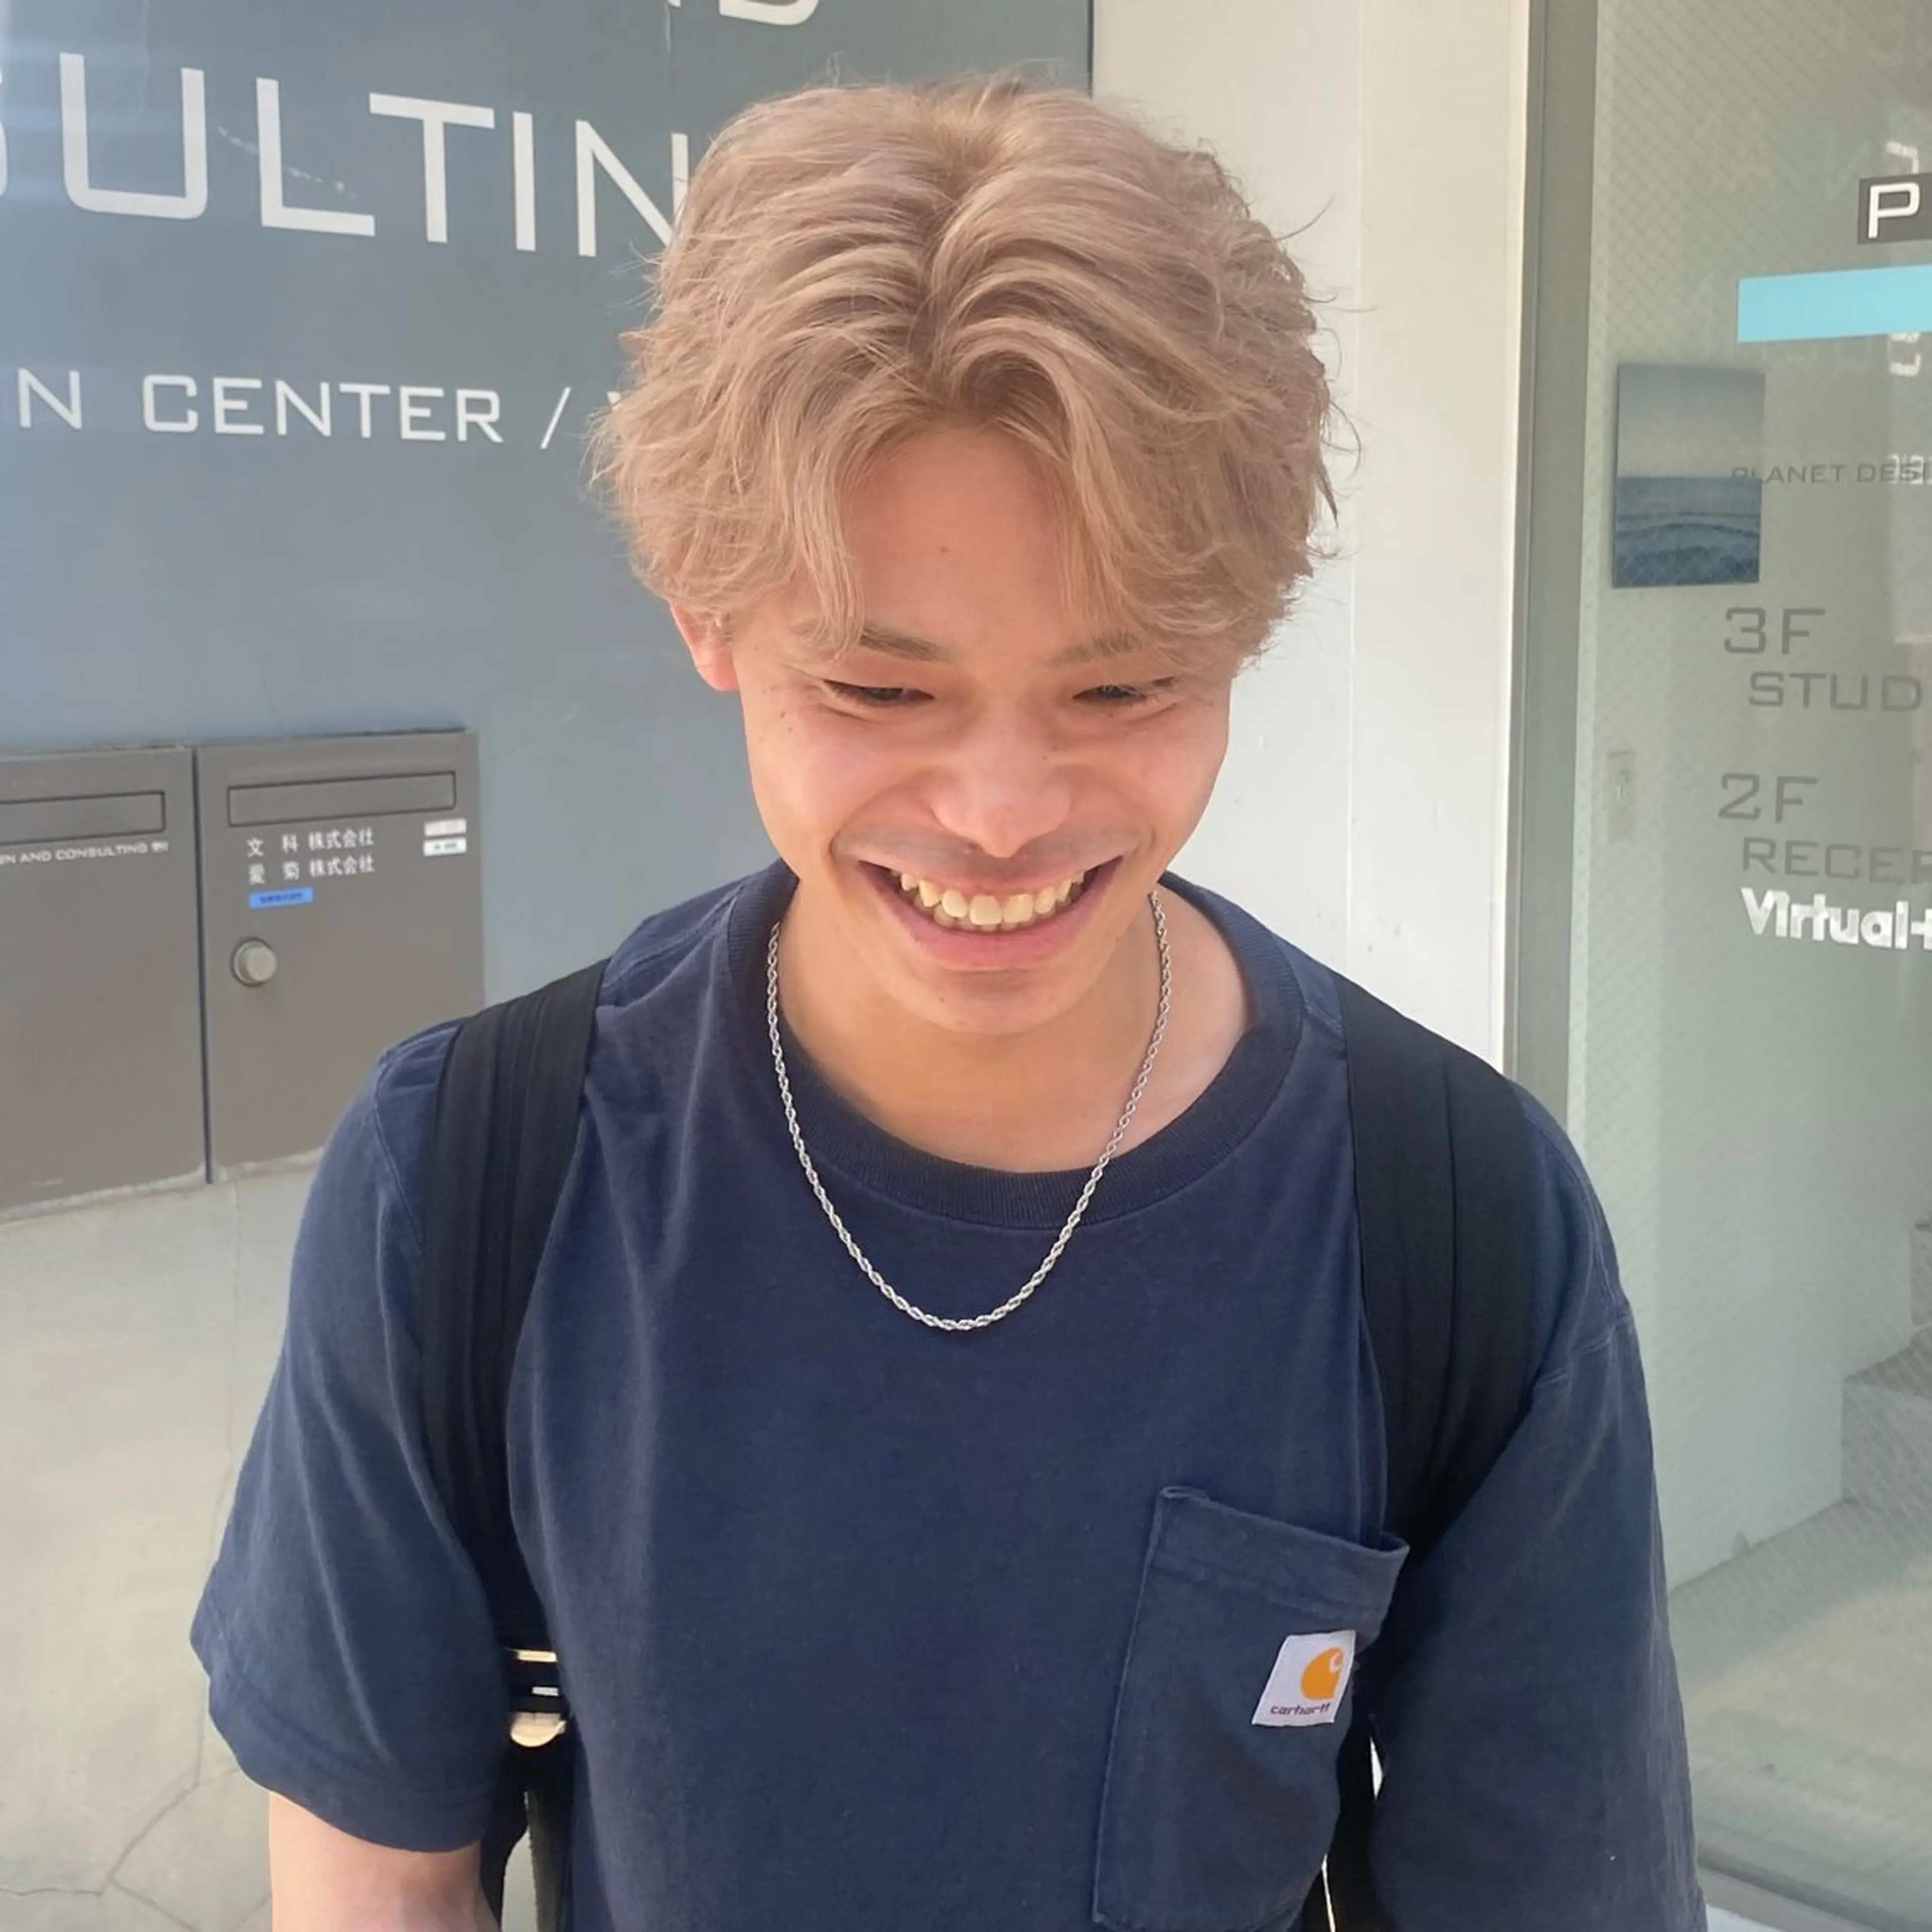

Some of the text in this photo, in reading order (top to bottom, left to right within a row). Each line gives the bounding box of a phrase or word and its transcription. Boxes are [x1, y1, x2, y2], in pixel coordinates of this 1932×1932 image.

[0, 52, 688, 257] ULTIN
[1868, 182, 1919, 238] P
[142, 374, 504, 443] CENTER
[1724, 607, 1826, 655] 3F
[1749, 672, 1923, 712] STUD
[1718, 774, 1818, 823] 2F
[20, 850, 51, 864] AND
